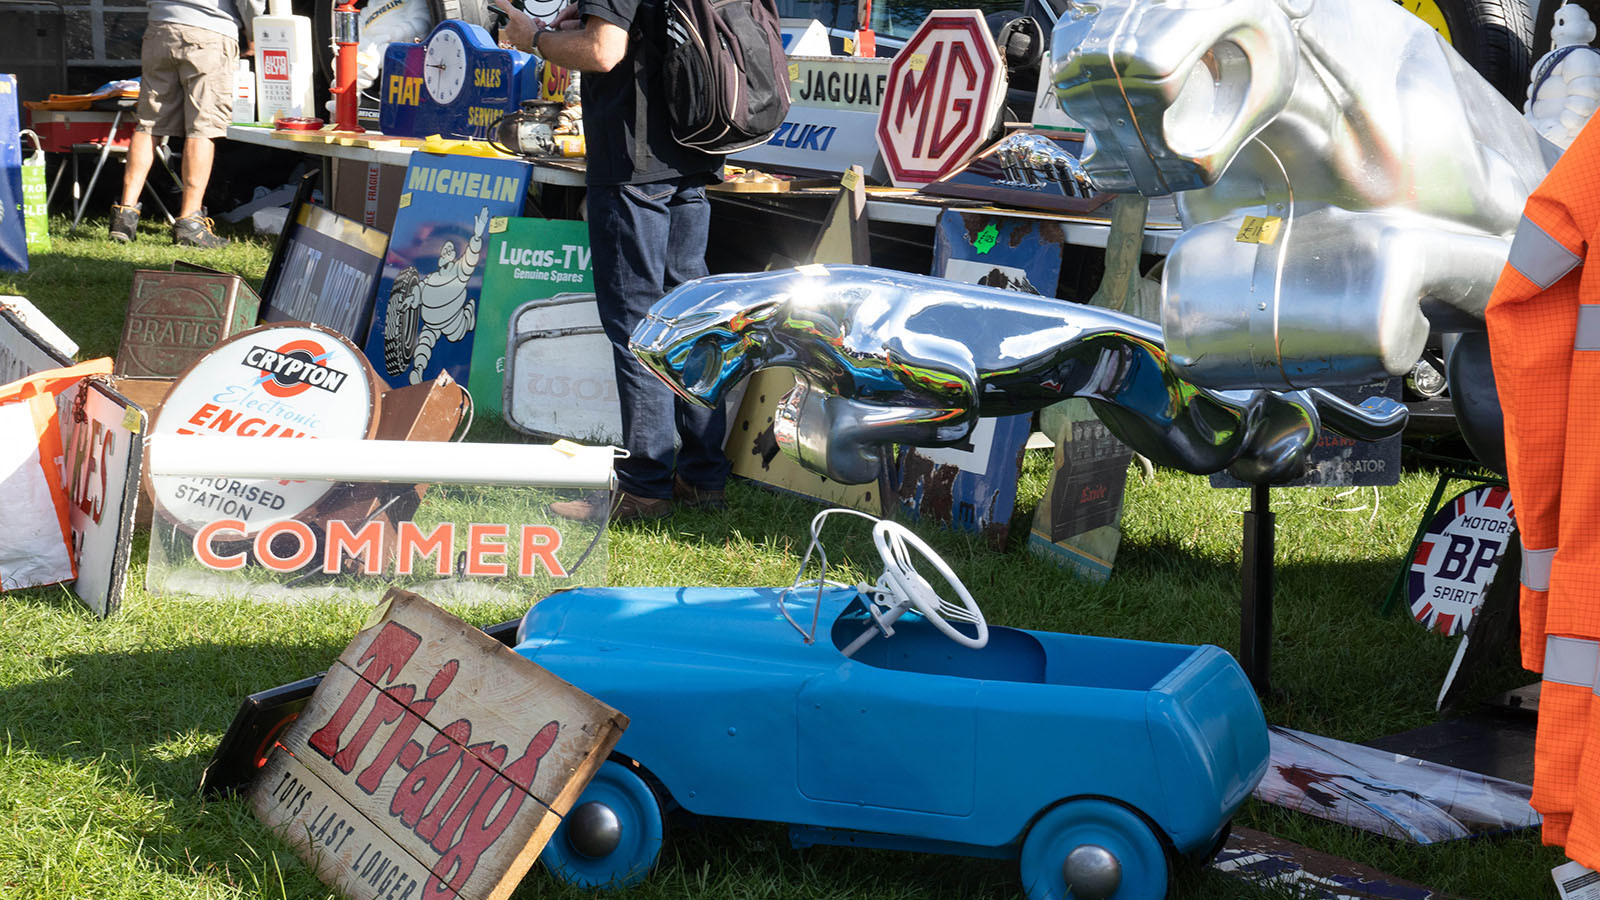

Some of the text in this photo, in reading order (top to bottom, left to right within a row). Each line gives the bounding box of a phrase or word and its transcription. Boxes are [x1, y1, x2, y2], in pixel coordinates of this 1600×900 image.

[265, 55, 286, 65] AUTO
[388, 74, 424, 107] FIAT
[474, 68, 501, 88] SALES
[895, 41, 978, 159] MG
[367, 167, 379, 201] FRAGILE
[408, 166, 519, 203] MICHELIN
[514, 267, 584, 284] Genuine Spares
[127, 318, 219, 347] PRATTS
[246, 348, 346, 392] CRYPTON
[212, 385, 321, 429] Electronic
[175, 484, 253, 520] STATION
[192, 518, 570, 578] COMMER
[1433, 586, 1478, 604] SPIRIT
[272, 771, 418, 900] TOYS LAST LONGER
